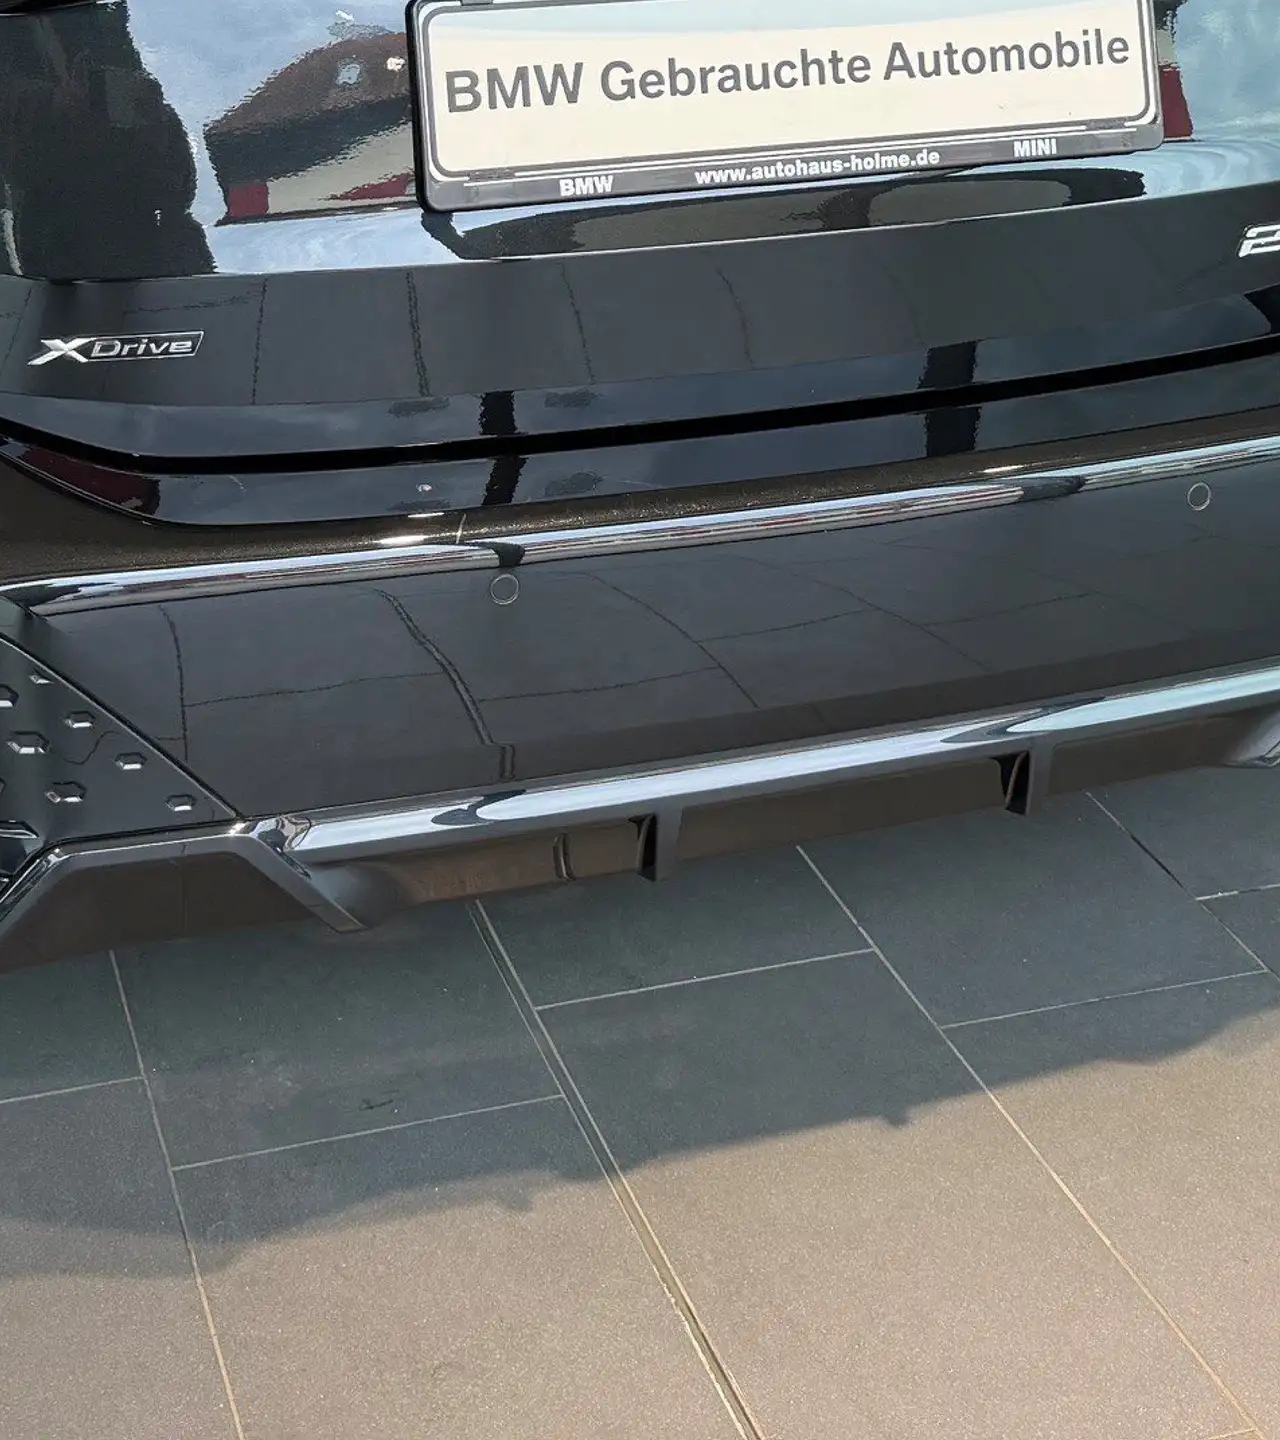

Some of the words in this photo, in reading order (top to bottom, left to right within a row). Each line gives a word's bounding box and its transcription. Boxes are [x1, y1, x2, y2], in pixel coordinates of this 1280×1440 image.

[445, 61, 584, 113] BMW
[600, 47, 872, 101] Gebrauchte
[883, 28, 1130, 81] Automobile
[559, 174, 614, 197] BMW
[694, 148, 940, 185] www.autohaus-holme.de
[1013, 137, 1058, 158] MINI
